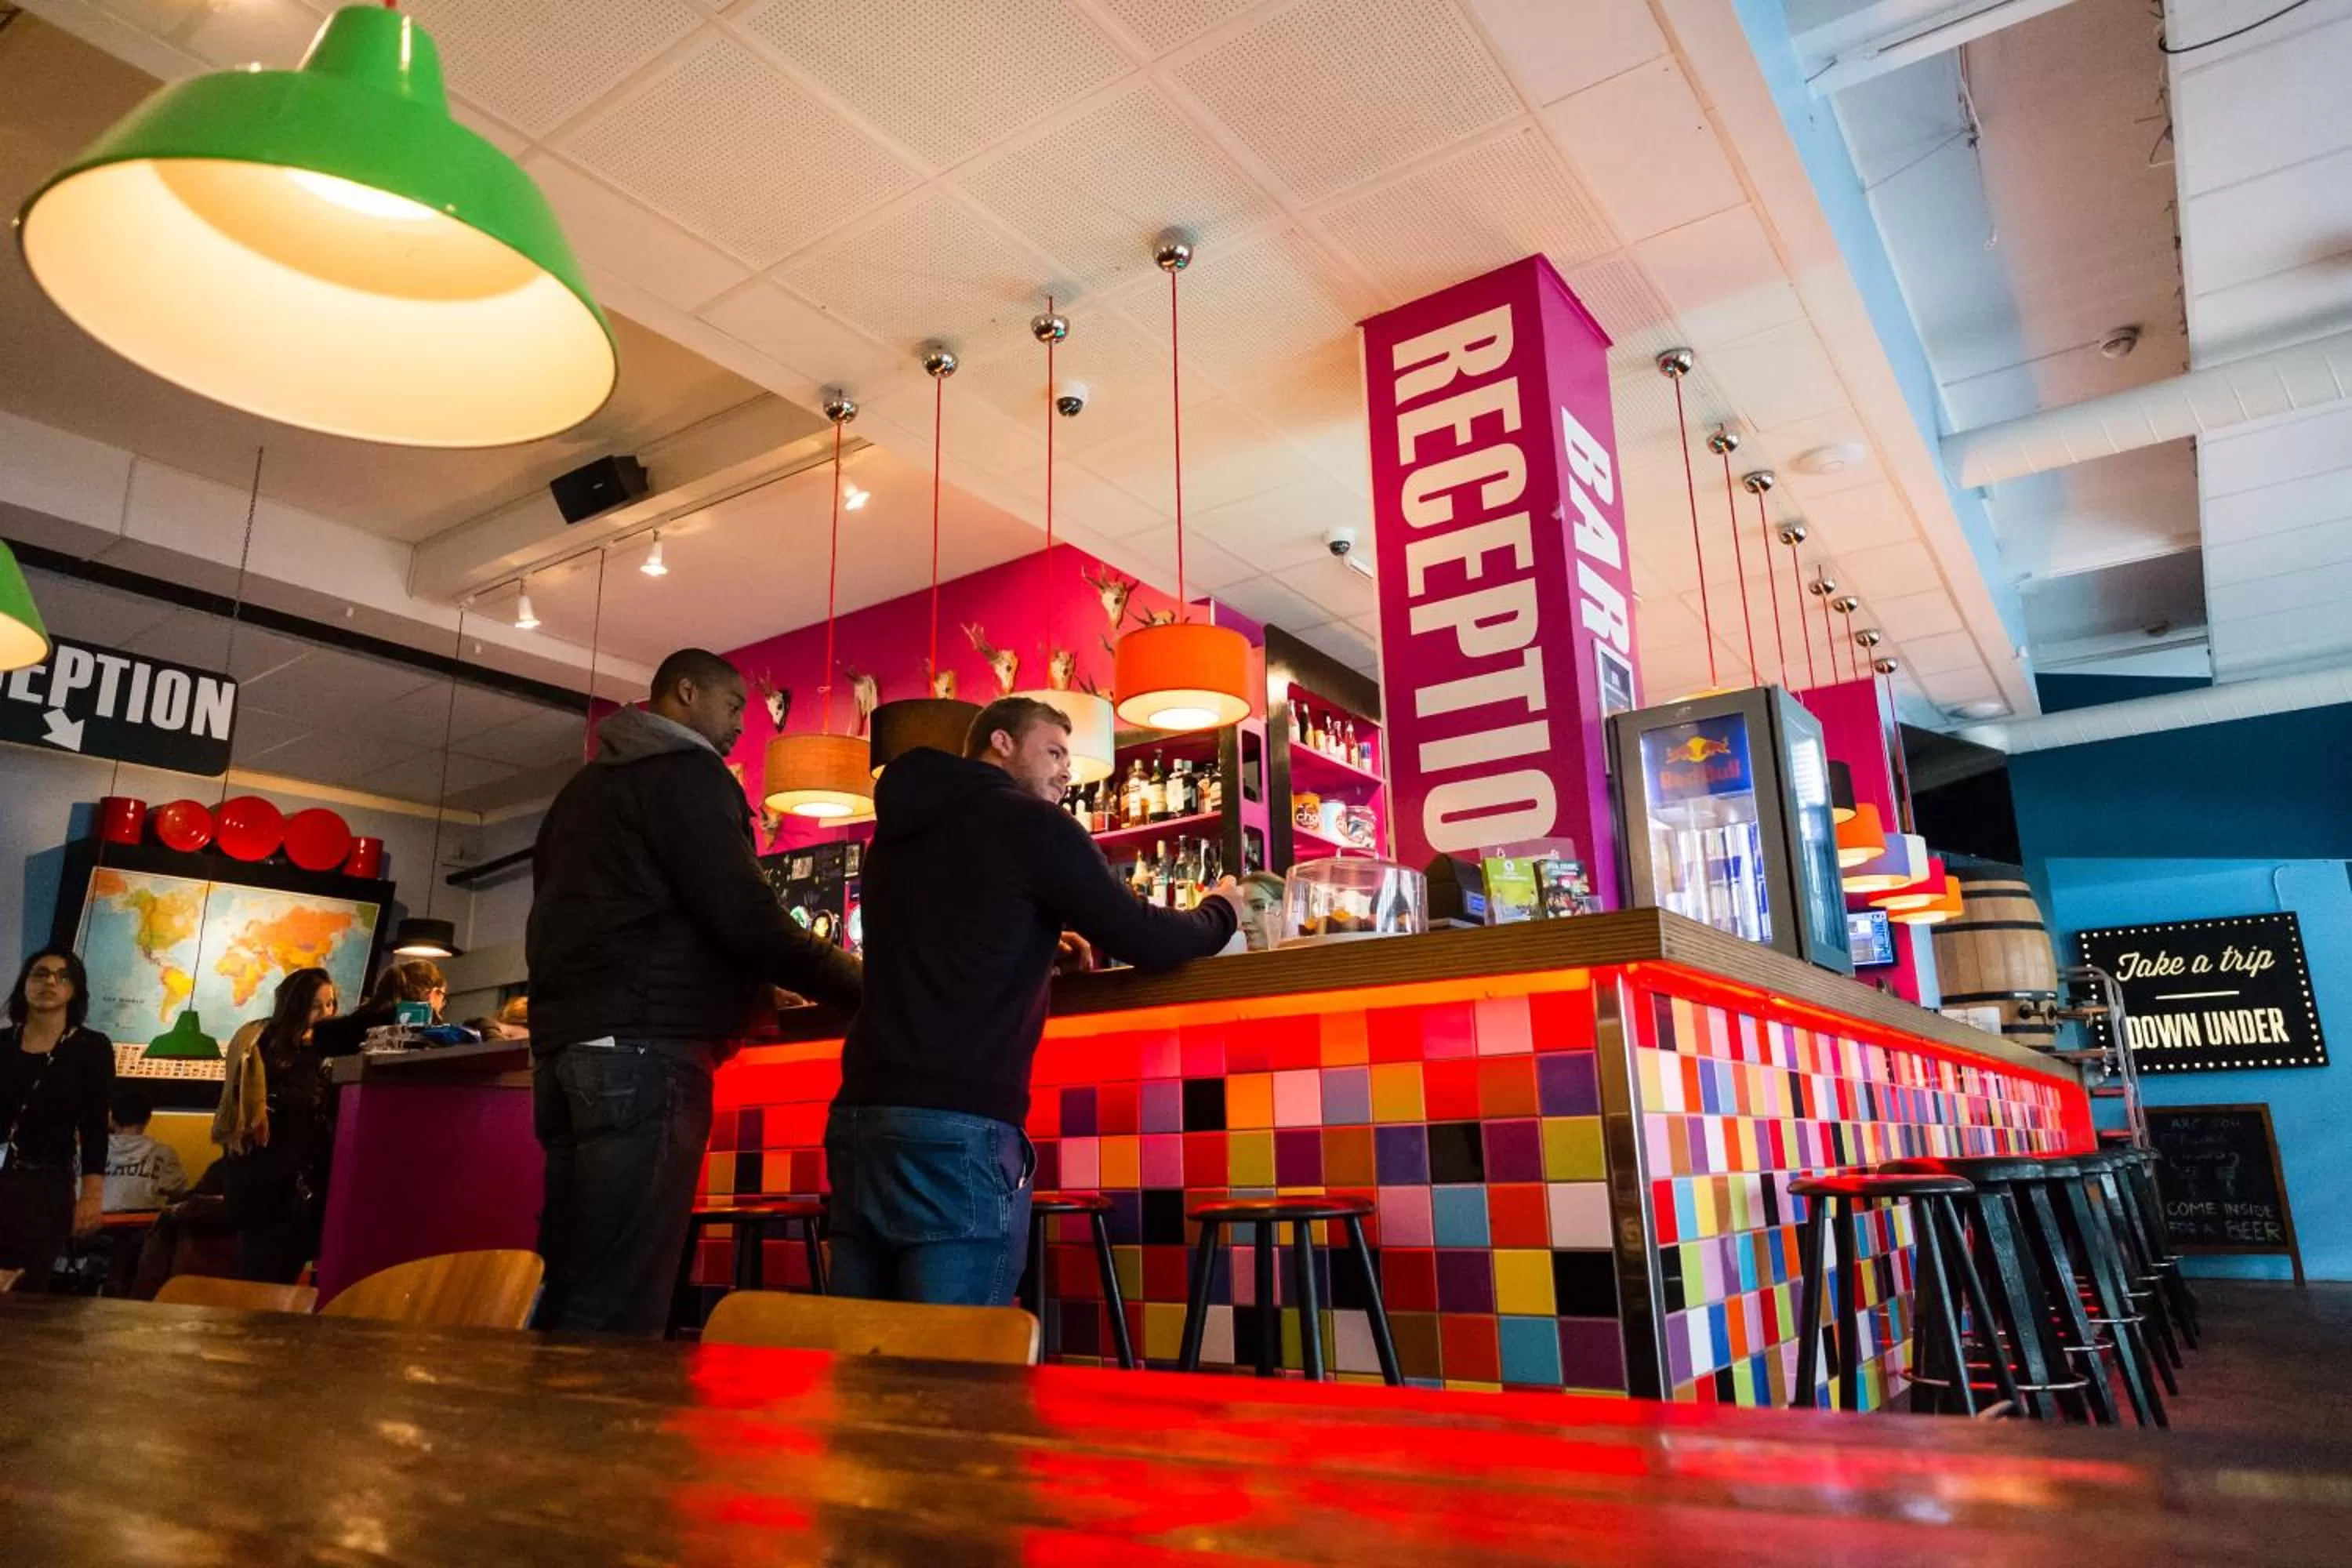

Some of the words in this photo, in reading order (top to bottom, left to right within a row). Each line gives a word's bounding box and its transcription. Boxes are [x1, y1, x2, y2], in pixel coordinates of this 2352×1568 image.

[1561, 405, 1630, 655] BAR
[1392, 303, 1557, 855] RECEPTIO
[0, 644, 236, 741] EPTION
[2116, 949, 2185, 982] Take
[2191, 954, 2212, 974] a
[2220, 945, 2275, 978] trip
[2125, 1013, 2201, 1049] DOWN
[2204, 1008, 2289, 1044] UNDER
[2166, 1201, 2218, 1216] COME
[2223, 1219, 2284, 1243] BEER
